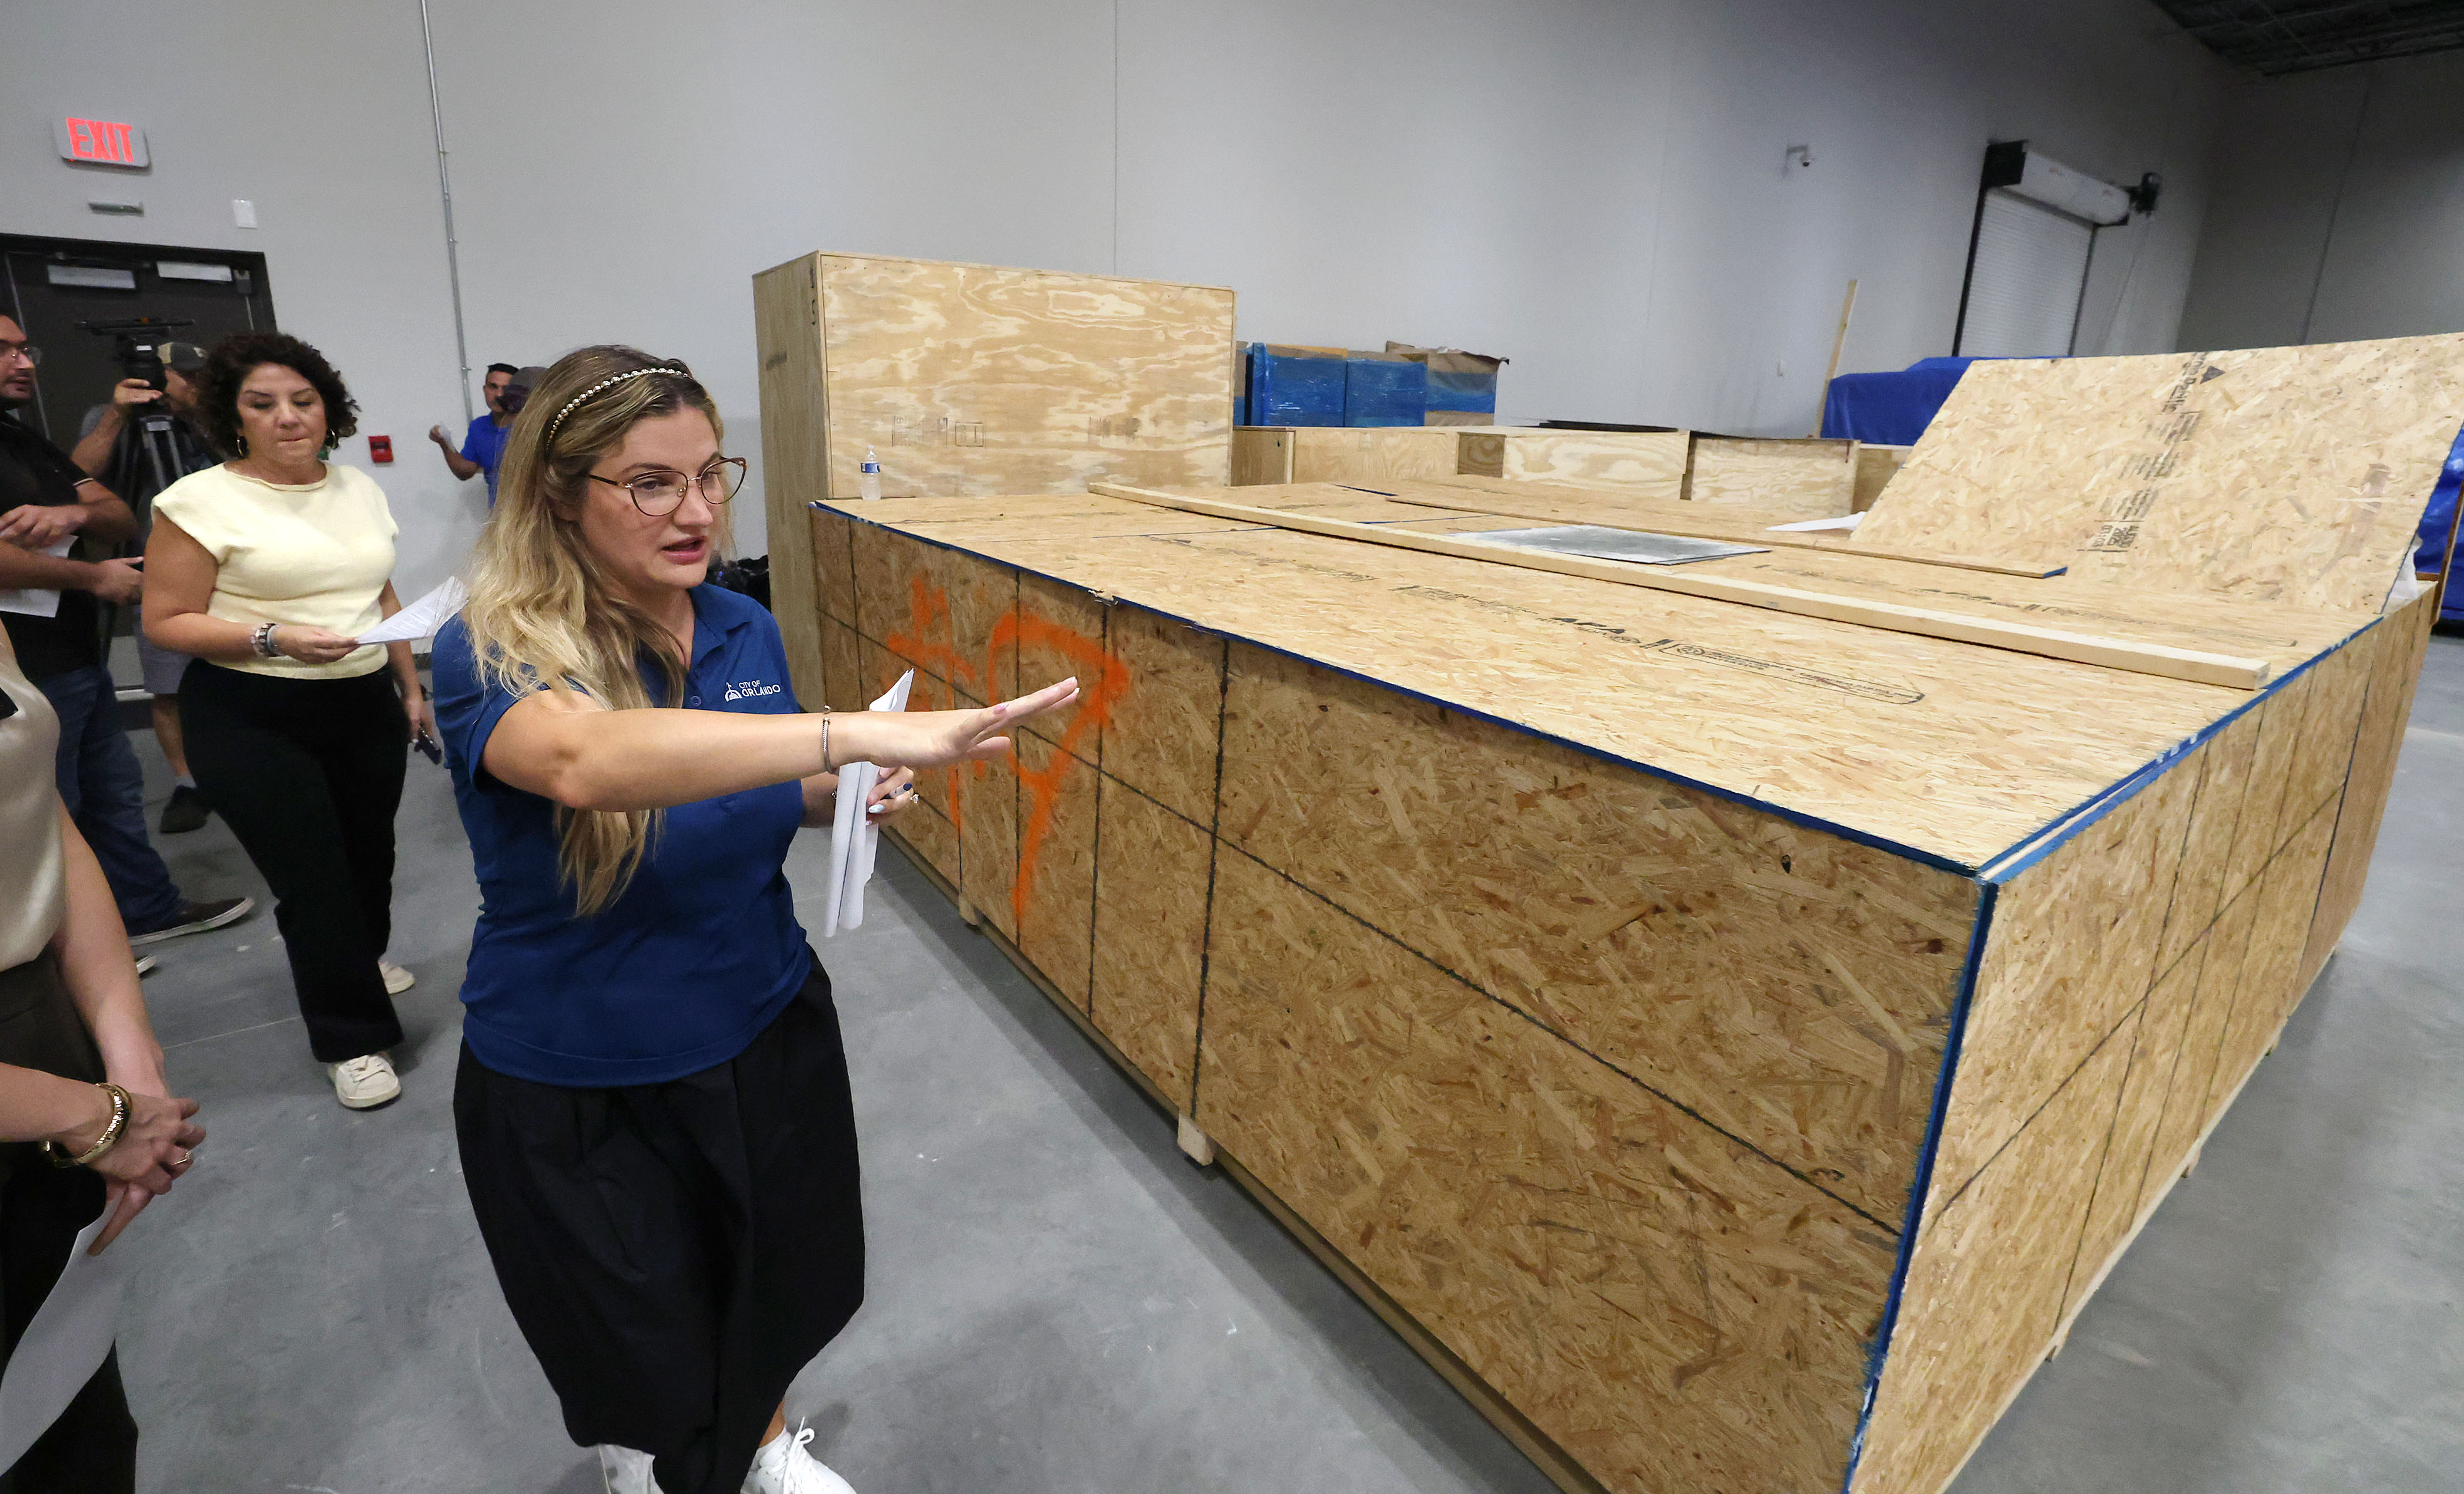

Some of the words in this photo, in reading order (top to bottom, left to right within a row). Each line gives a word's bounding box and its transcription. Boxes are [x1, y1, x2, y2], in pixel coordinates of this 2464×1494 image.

[65, 117, 134, 163] EXIT
[738, 681, 751, 689] CITY
[741, 684, 781, 697] ORLANDO
